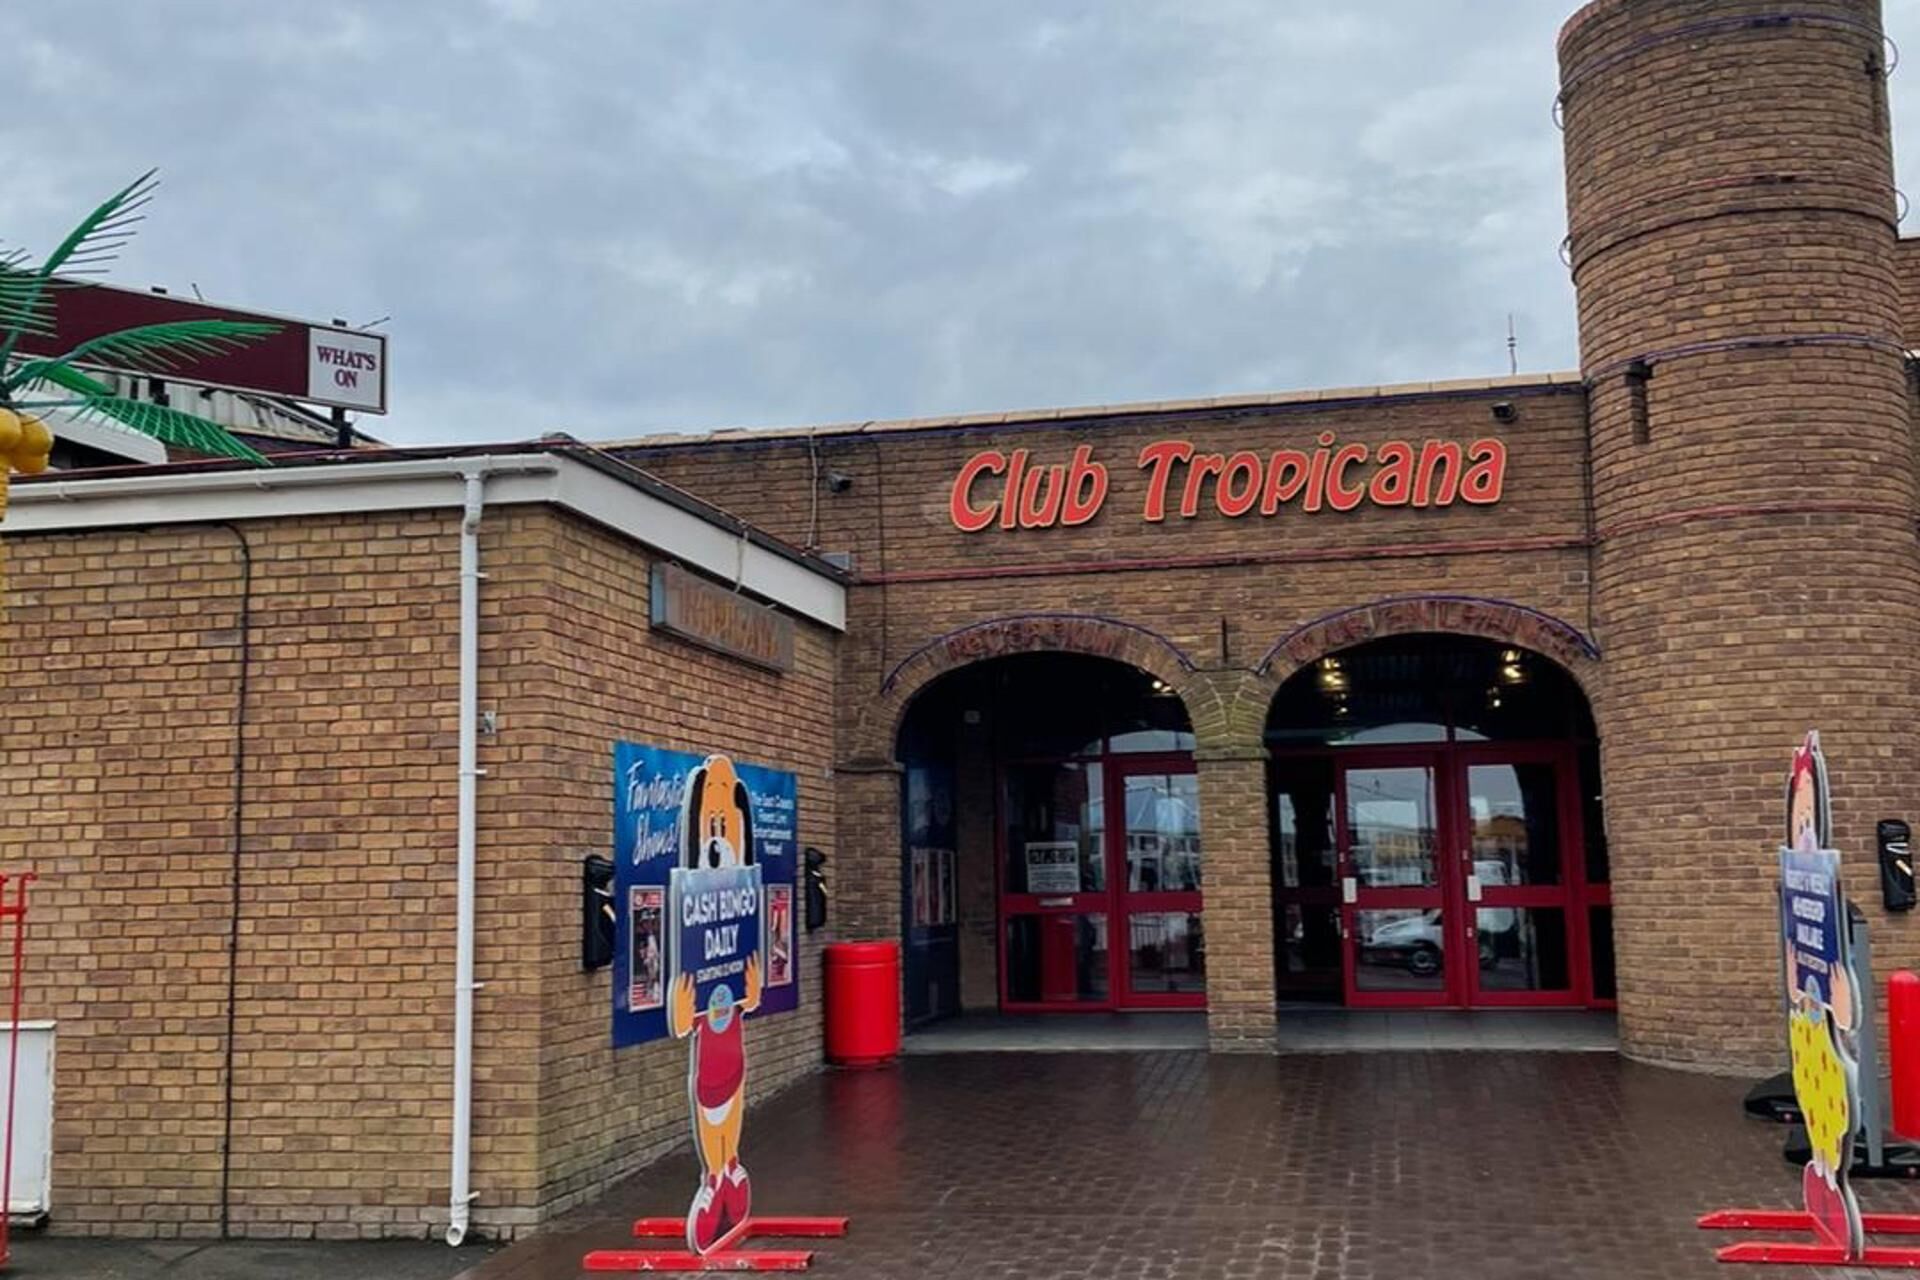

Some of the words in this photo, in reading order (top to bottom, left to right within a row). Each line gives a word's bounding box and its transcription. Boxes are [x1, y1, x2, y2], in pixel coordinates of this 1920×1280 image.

[317, 345, 377, 371] WHAT'S
[334, 368, 358, 388] ON
[950, 444, 1109, 532] Club
[1136, 430, 1507, 521] Tropicana
[683, 891, 718, 927] CASH
[719, 887, 757, 921] BINGO
[704, 923, 740, 961] DAILY
